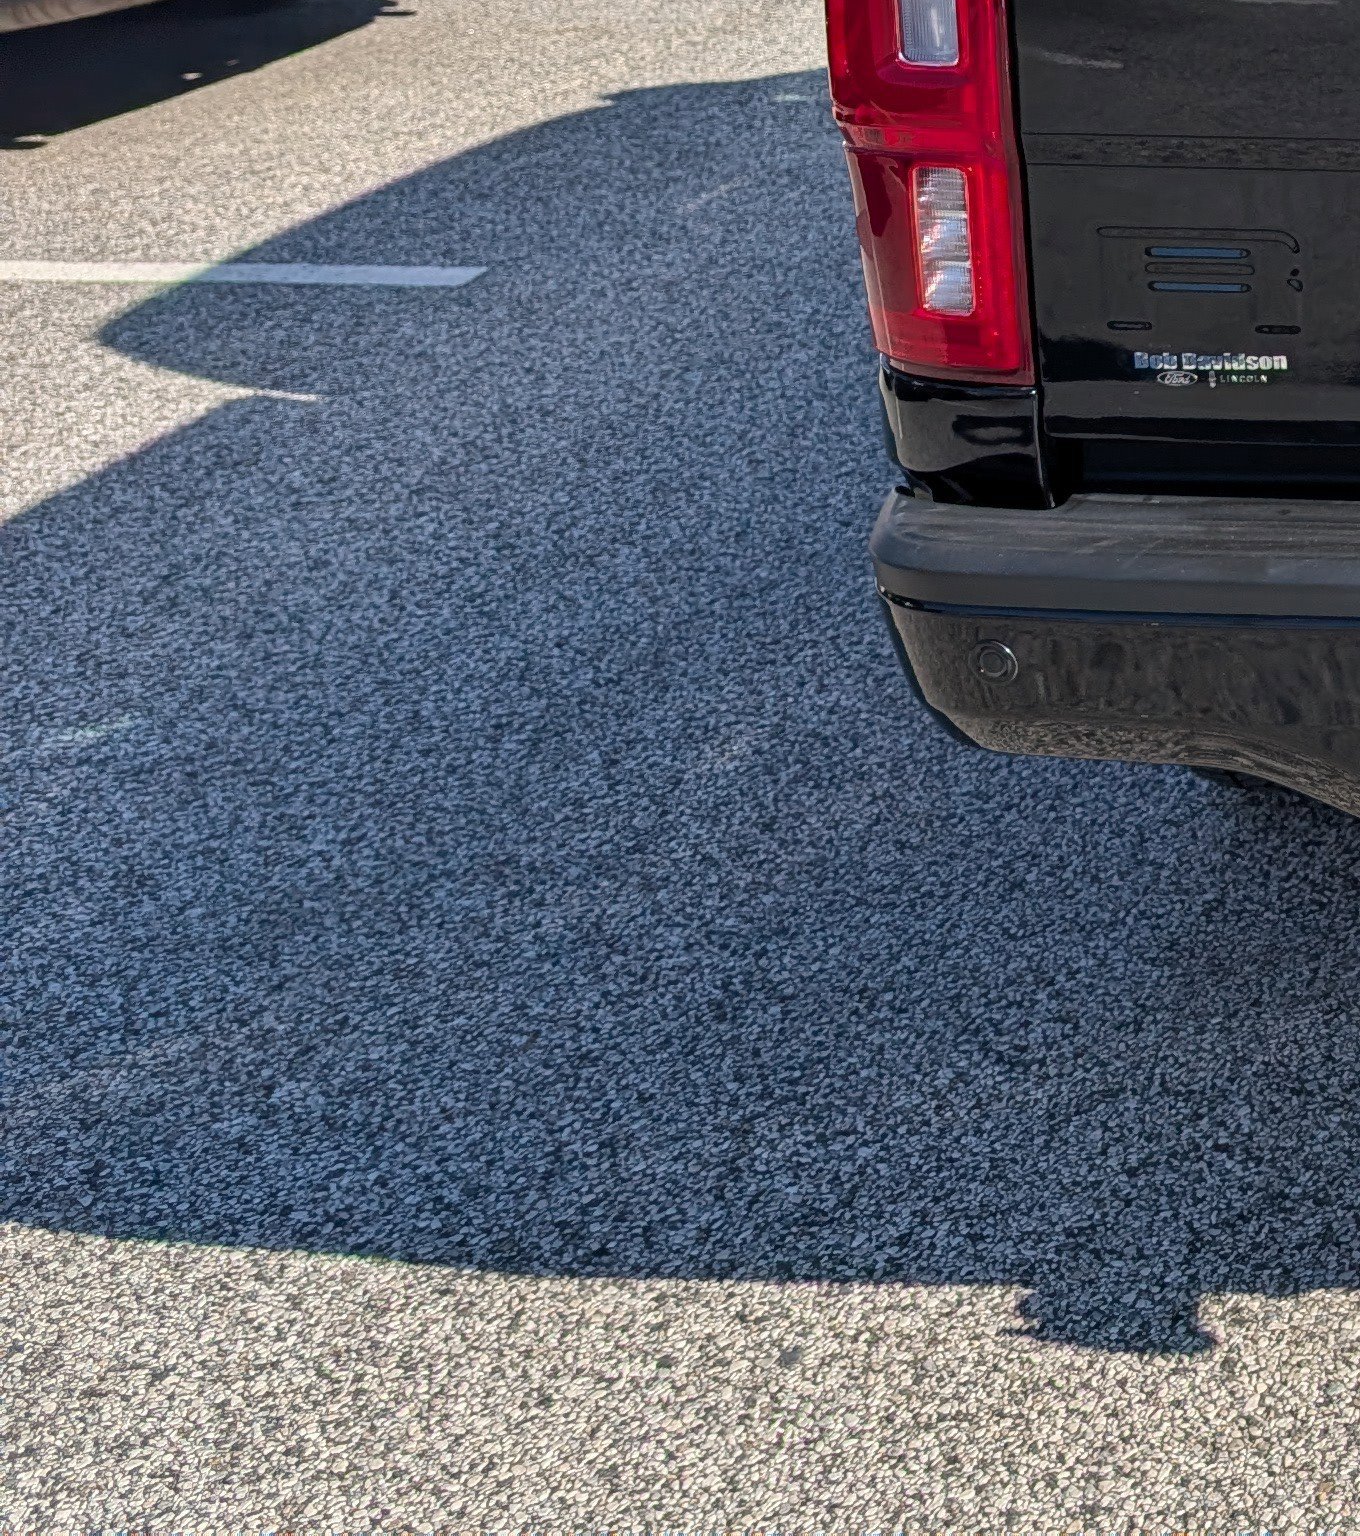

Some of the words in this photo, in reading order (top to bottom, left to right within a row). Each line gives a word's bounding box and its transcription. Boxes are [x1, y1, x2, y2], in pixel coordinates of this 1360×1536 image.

[1134, 351, 1178, 370] Bob
[1181, 352, 1288, 371] Davidson
[1220, 374, 1268, 383] LINCOLN
